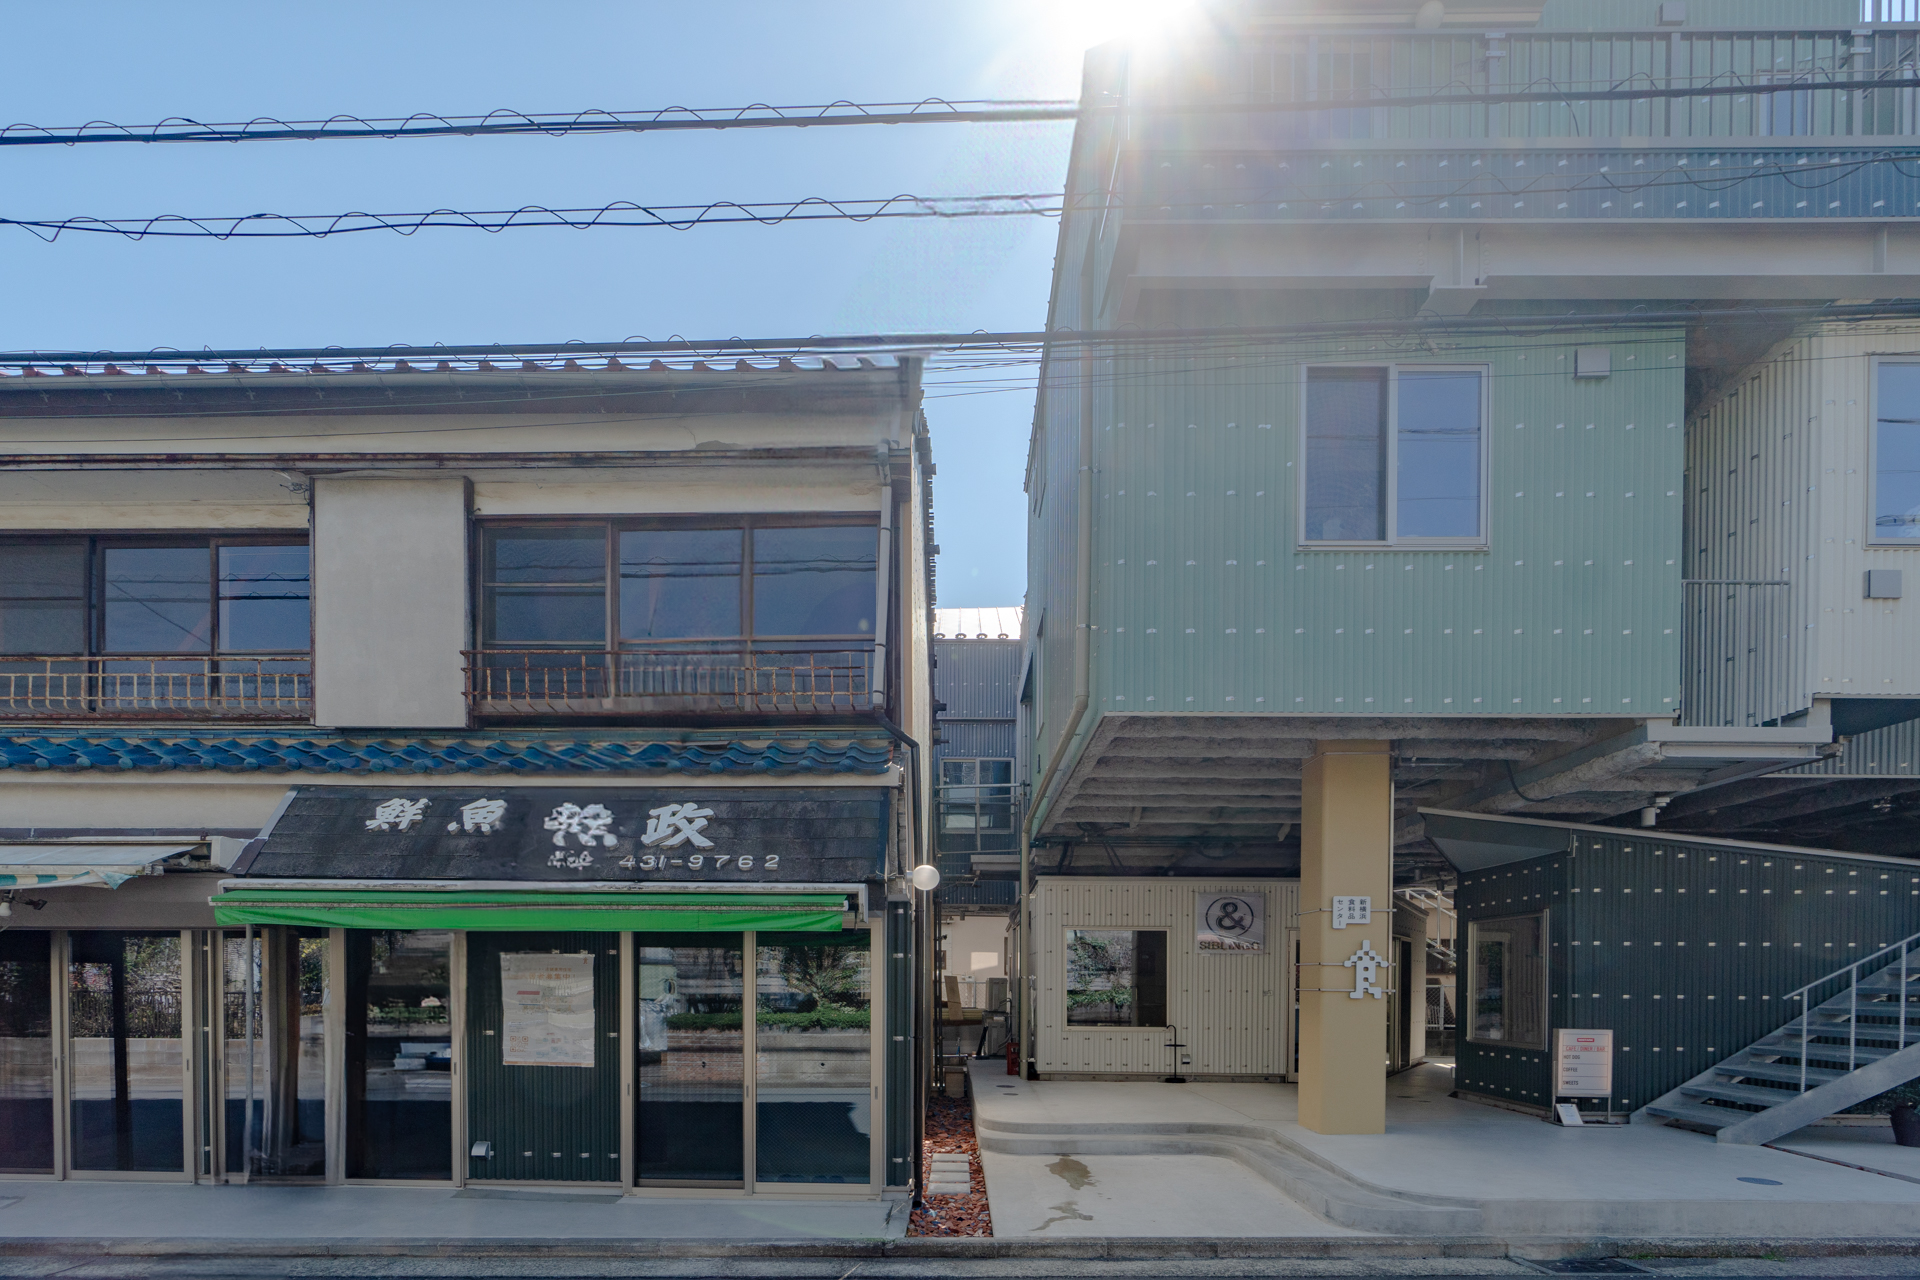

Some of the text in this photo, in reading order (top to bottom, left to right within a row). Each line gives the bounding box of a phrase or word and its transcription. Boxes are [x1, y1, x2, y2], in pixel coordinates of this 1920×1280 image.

[364, 798, 507, 835] 鮮魚
[618, 854, 781, 871] 431-9762
[1216, 902, 1246, 930] &
[1359, 899, 1367, 920] 新横浜
